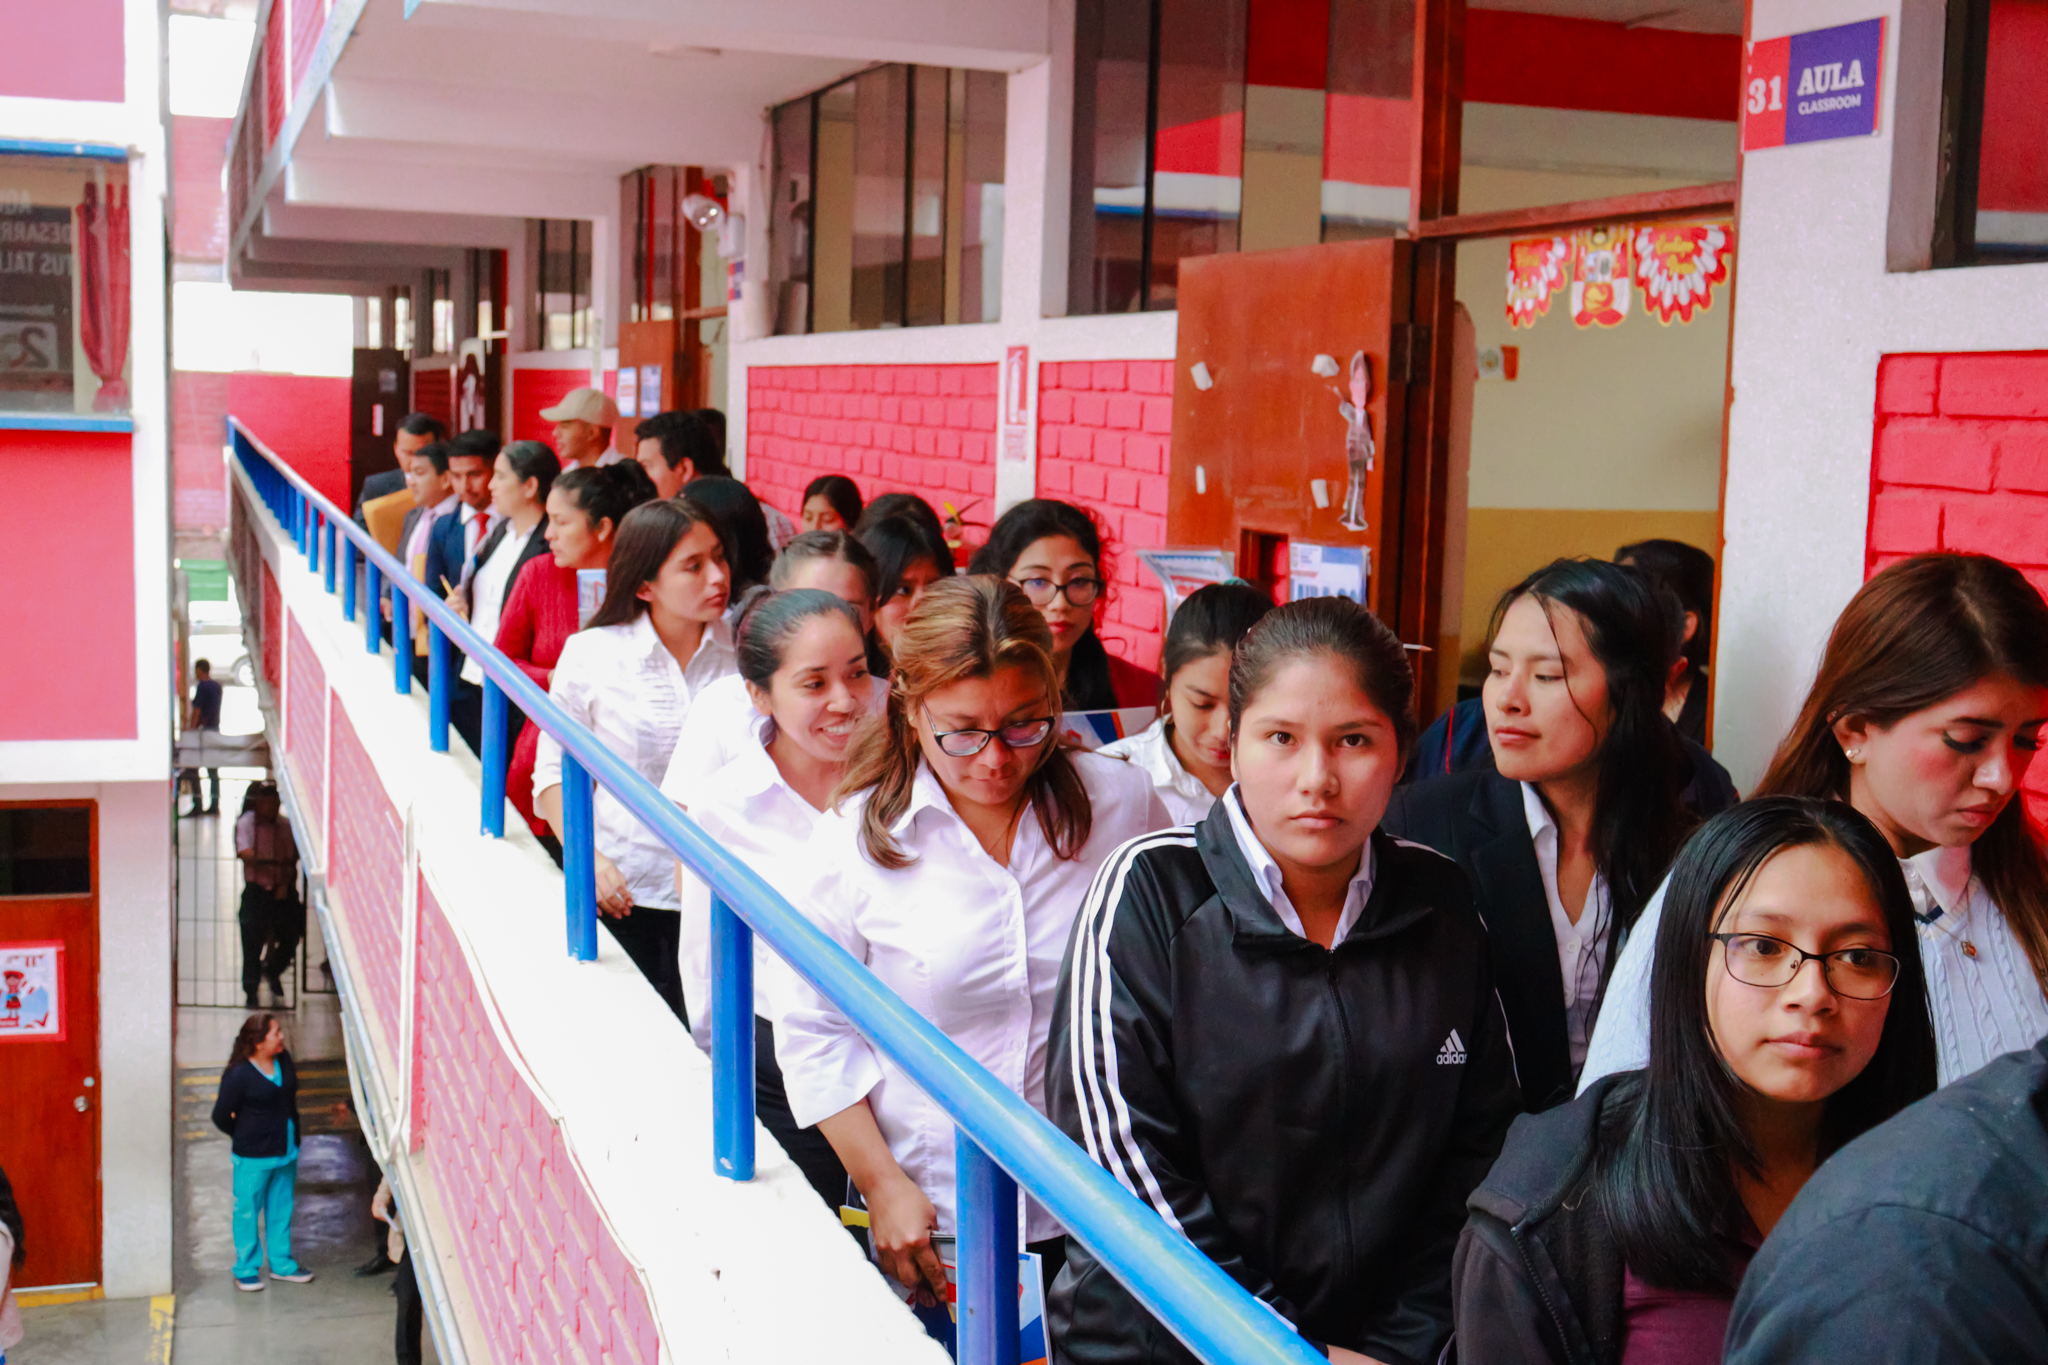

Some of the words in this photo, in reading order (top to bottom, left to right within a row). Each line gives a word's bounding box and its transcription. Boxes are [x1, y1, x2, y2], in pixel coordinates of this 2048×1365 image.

[1748, 77, 1782, 114] 31
[1797, 60, 1865, 96] AULA
[1798, 94, 1861, 115] CLASSROOM
